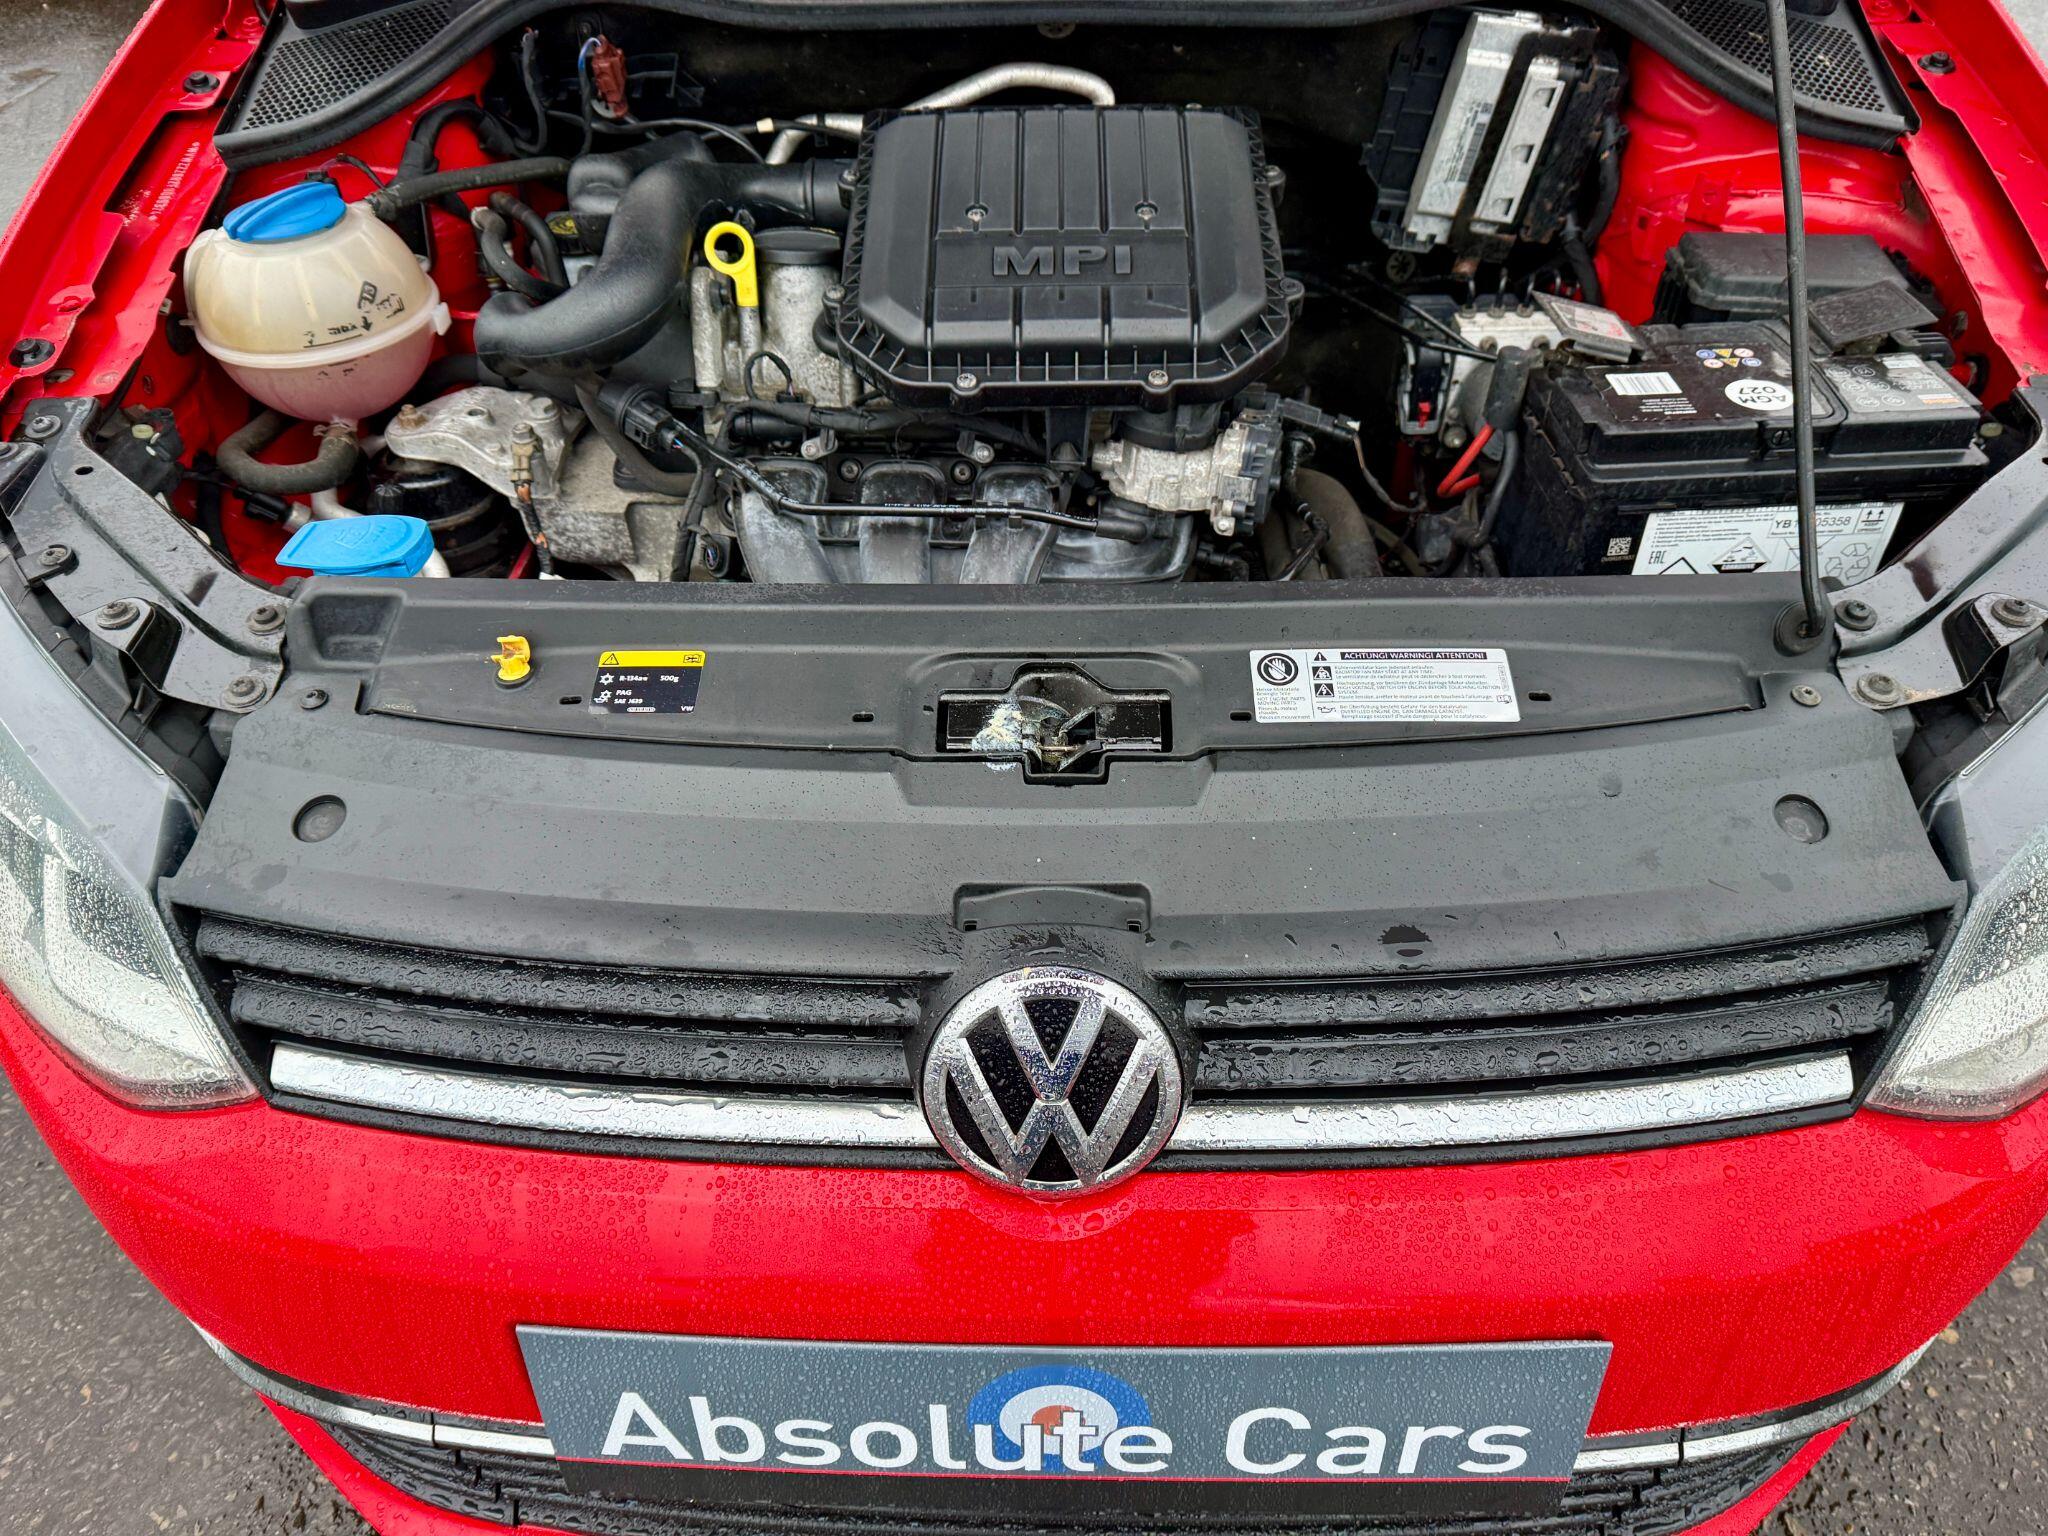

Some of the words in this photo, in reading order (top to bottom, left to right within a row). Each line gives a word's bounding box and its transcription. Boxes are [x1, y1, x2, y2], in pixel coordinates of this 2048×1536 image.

[993, 245, 1132, 276] MPI
[1738, 386, 1777, 395] 027
[1738, 395, 1786, 404] AGM
[660, 675, 680, 683] 500g
[600, 1391, 1174, 1473] Absolute
[1225, 1406, 1533, 1475] Cars
